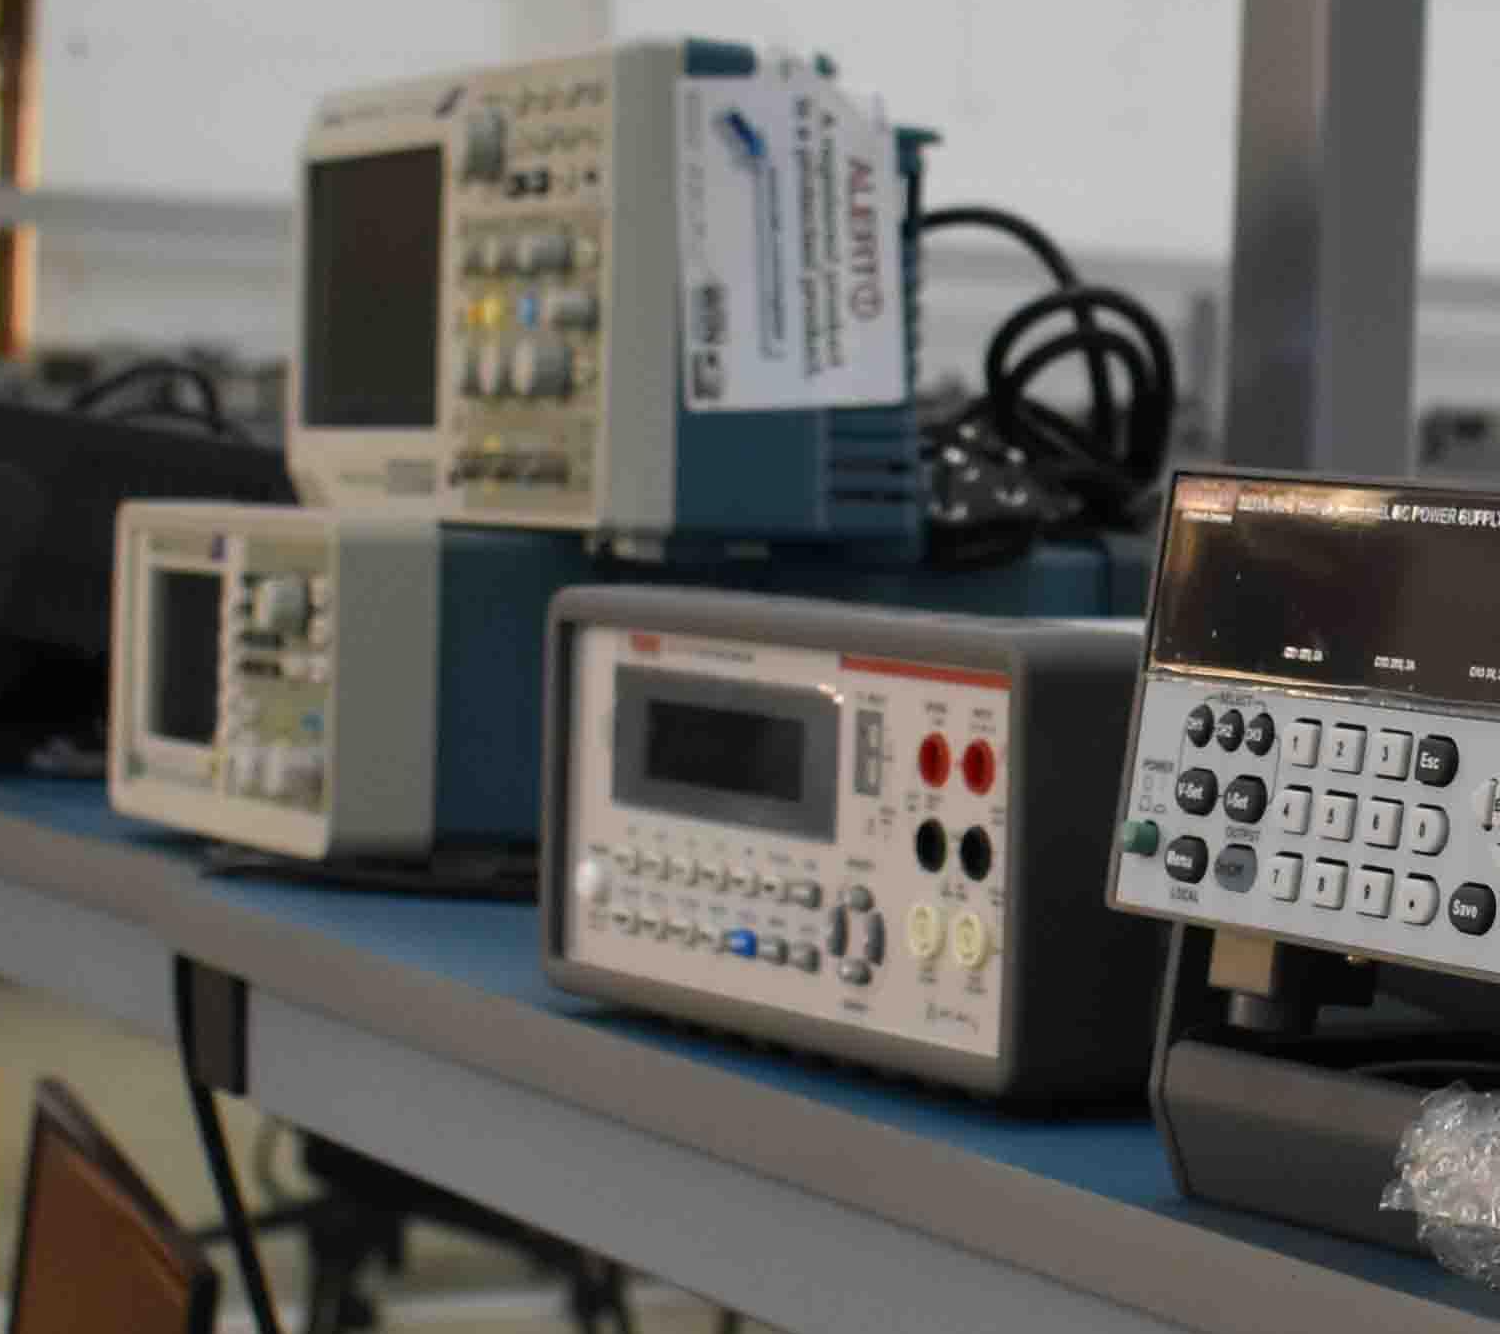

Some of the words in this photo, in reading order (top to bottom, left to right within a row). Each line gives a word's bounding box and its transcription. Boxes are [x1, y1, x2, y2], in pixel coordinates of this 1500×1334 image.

[1412, 505, 1456, 525] POWER
[1293, 736, 1300, 750] 1
[1336, 740, 1344, 756] 2
[1381, 745, 1389, 761] 3
[1420, 751, 1440, 770] Esc
[1328, 807, 1335, 824] 5
[1372, 813, 1380, 829] 6
[1419, 821, 1426, 838] 0
[1273, 868, 1280, 883] 7
[1317, 876, 1325, 892] 8
[1363, 883, 1371, 899] 9
[1170, 887, 1199, 903] LOCAL
[1452, 900, 1478, 918] Save
